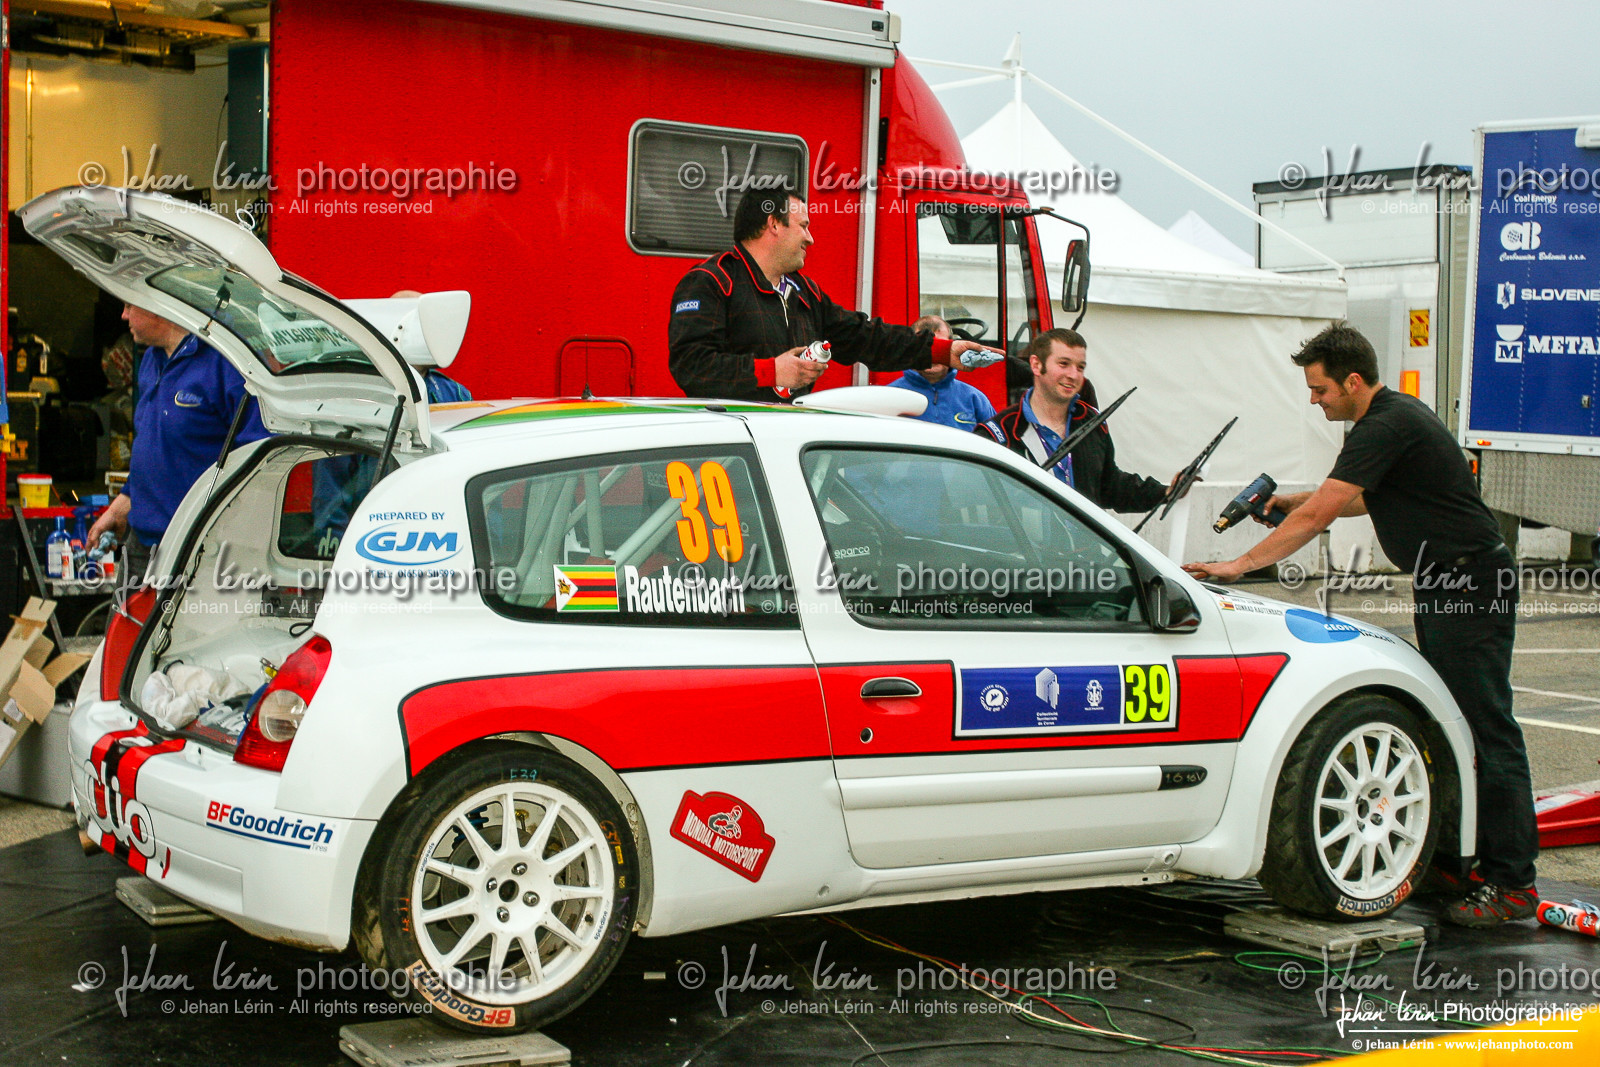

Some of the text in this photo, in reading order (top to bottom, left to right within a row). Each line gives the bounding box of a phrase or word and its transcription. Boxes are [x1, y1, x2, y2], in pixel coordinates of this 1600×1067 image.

[1514, 193, 1557, 204] Coal Energy
[1521, 288, 1600, 302] SLOVENE
[1528, 334, 1600, 355] META
[369, 512, 446, 522] PREPARED BY
[665, 461, 744, 564] 39
[366, 532, 458, 552] GJM
[624, 565, 746, 614] Rautenbach
[1124, 664, 1170, 722] 39
[206, 800, 334, 844] BFGoodrich
[312, 842, 328, 852] Tires
[680, 808, 764, 872] MONDIAL MOTORSPORT
[1339, 882, 1410, 915] BFGoodrich
[412, 965, 511, 1024] BFGoodrich
